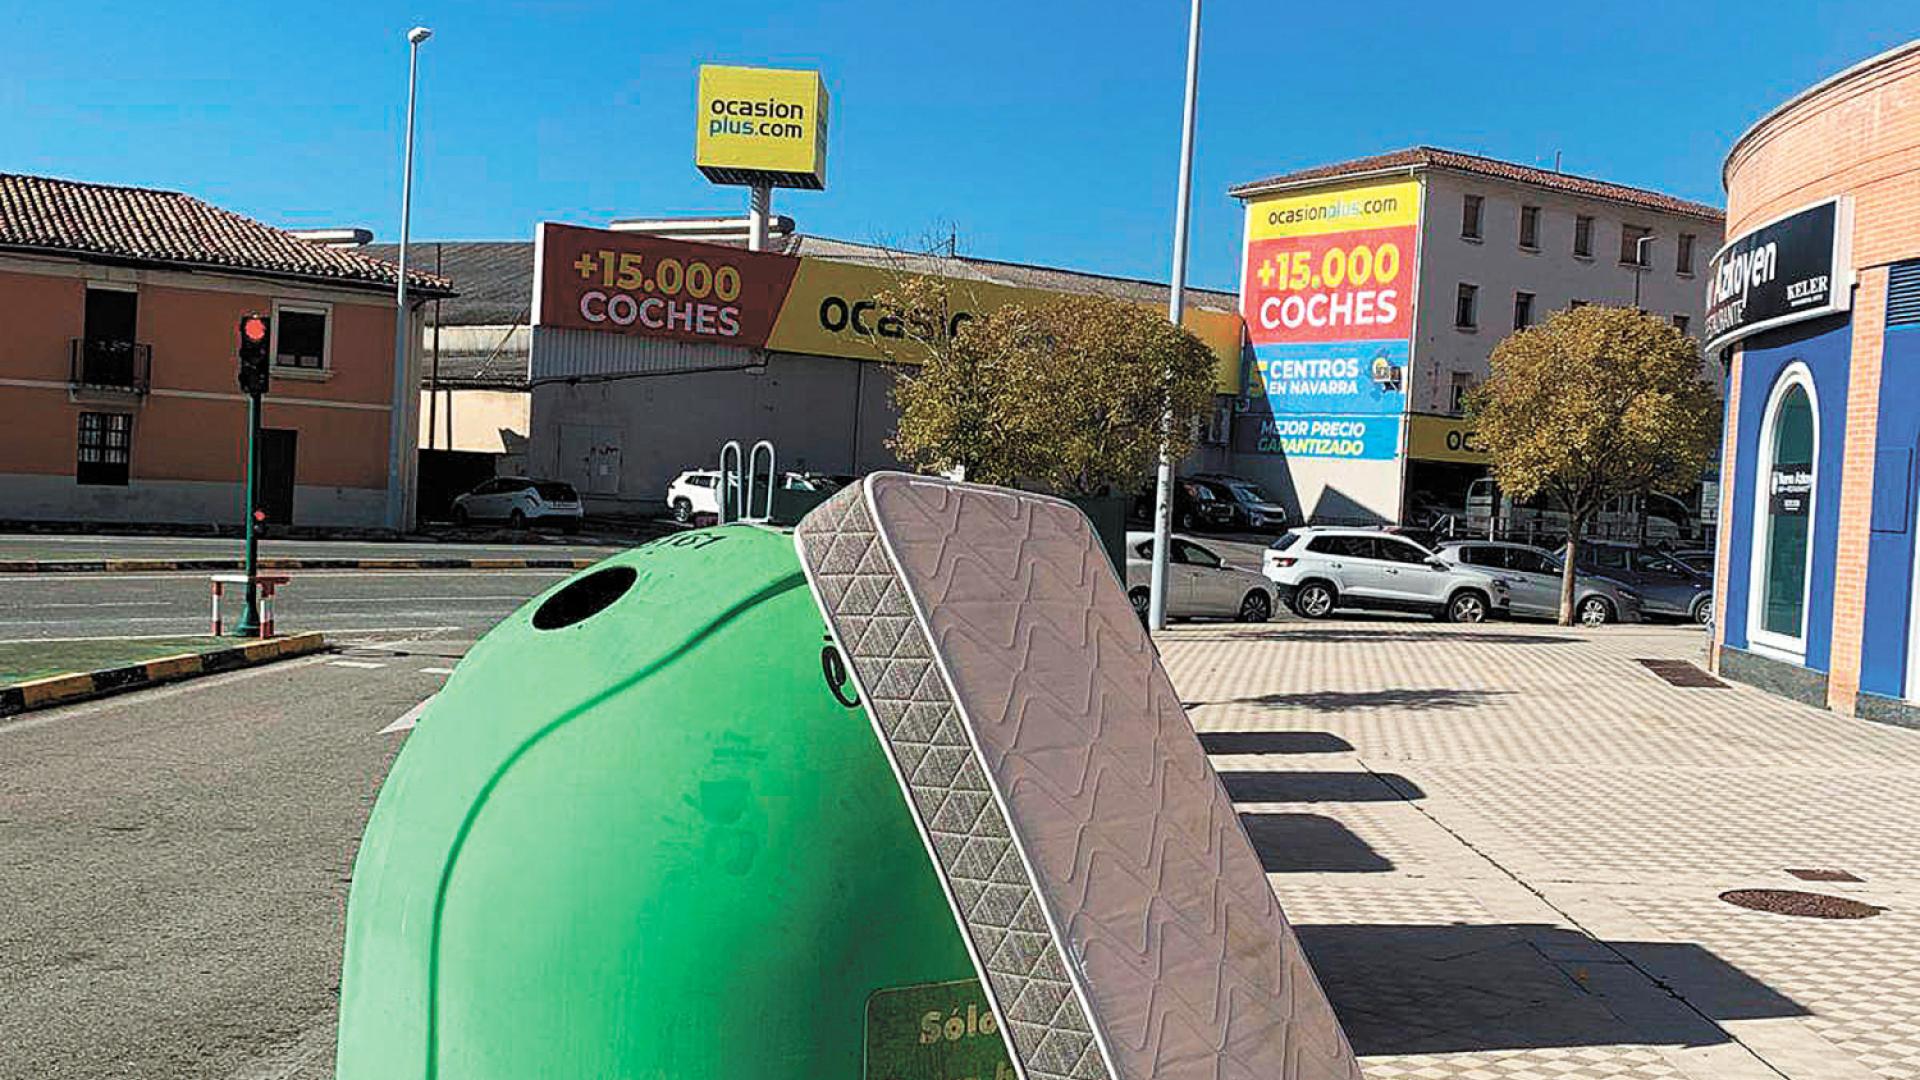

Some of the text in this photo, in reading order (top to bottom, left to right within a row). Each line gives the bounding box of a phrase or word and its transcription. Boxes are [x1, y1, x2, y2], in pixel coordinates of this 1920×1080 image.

[711, 98, 803, 119] ocasion
[710, 116, 802, 138] plus.com
[1268, 198, 1398, 225] ocasionplus.com
[574, 250, 741, 302] +15.000
[1257, 243, 1399, 290] +15.000
[1786, 275, 1828, 300] KELER
[580, 291, 739, 336] COCHES
[1260, 289, 1398, 329] COCHES
[1270, 358, 1359, 379] CENTROS
[1269, 380, 1359, 395] EN NAVARRA
[1260, 421, 1366, 437] MEJOR PRECIO
[1257, 438, 1365, 456] GARANTIZADO
[919, 1003, 998, 1044] Sólo
